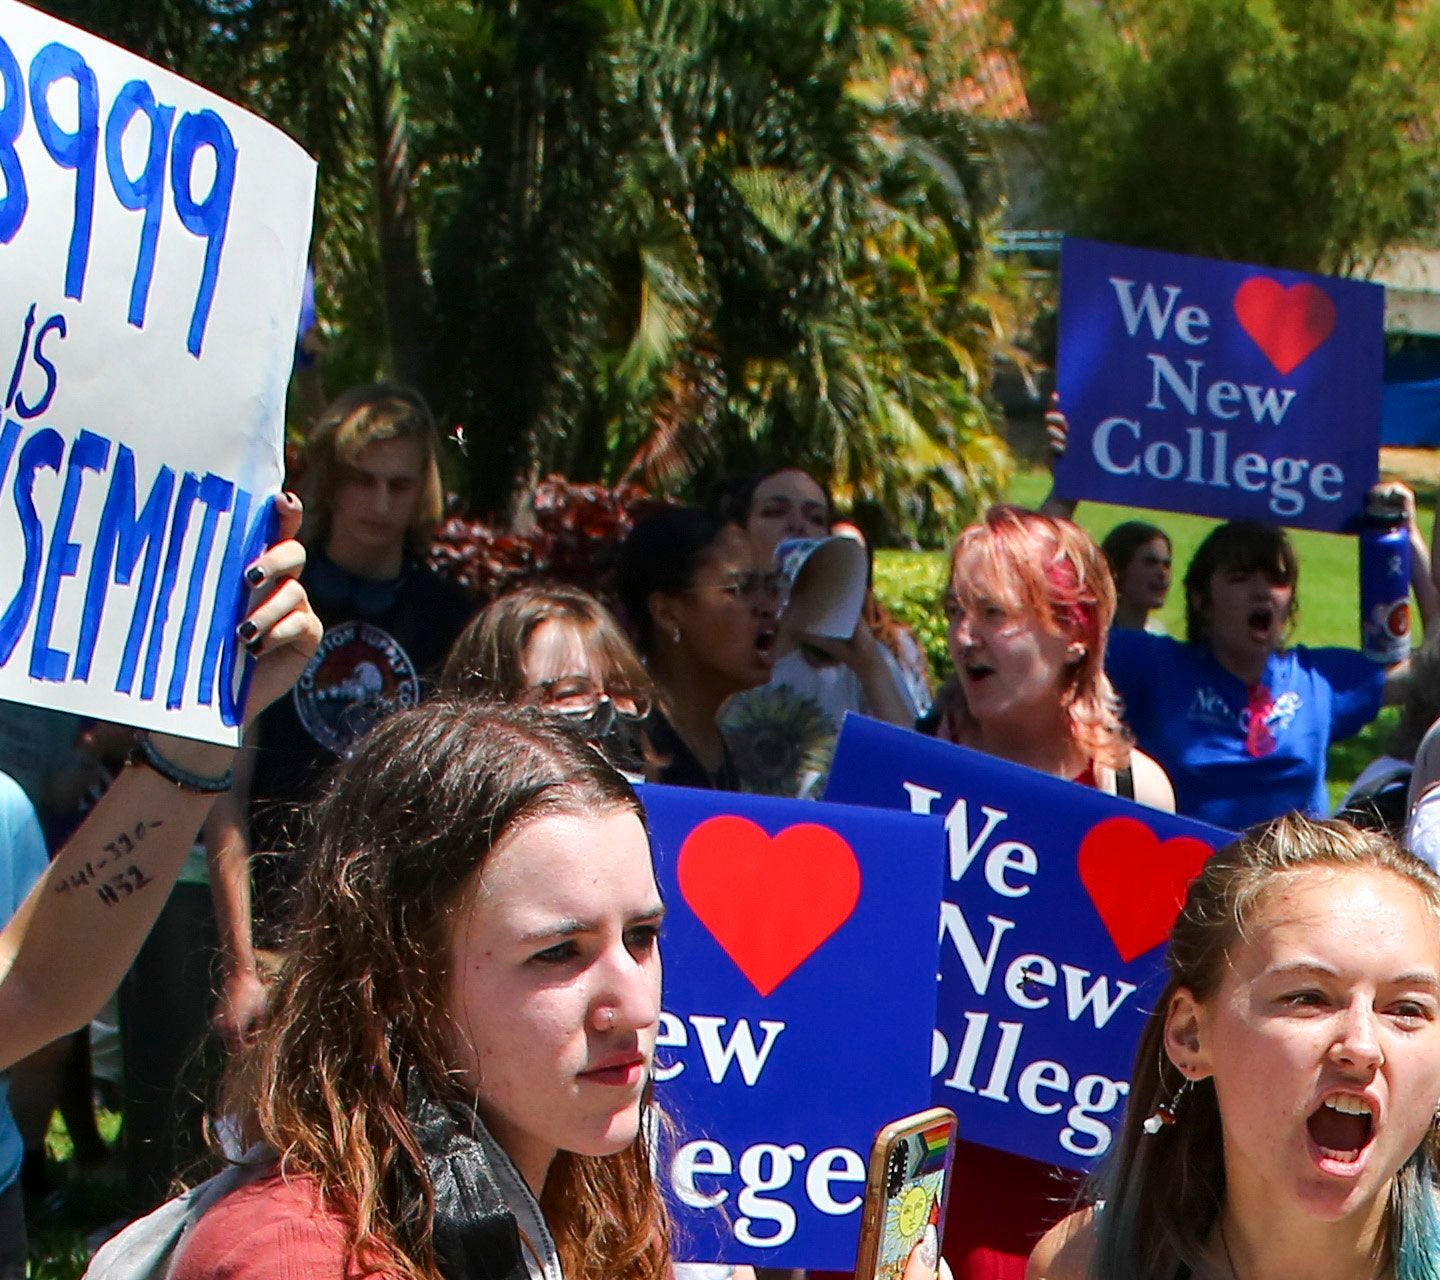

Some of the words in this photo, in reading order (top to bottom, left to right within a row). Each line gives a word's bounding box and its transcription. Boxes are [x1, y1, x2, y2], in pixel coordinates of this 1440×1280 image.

[6, 303, 68, 420] IS
[1109, 277, 1211, 346] We
[1146, 352, 1297, 427] New
[1091, 416, 1345, 517] College
[903, 782, 1039, 899] We
[936, 900, 1138, 1029] New
